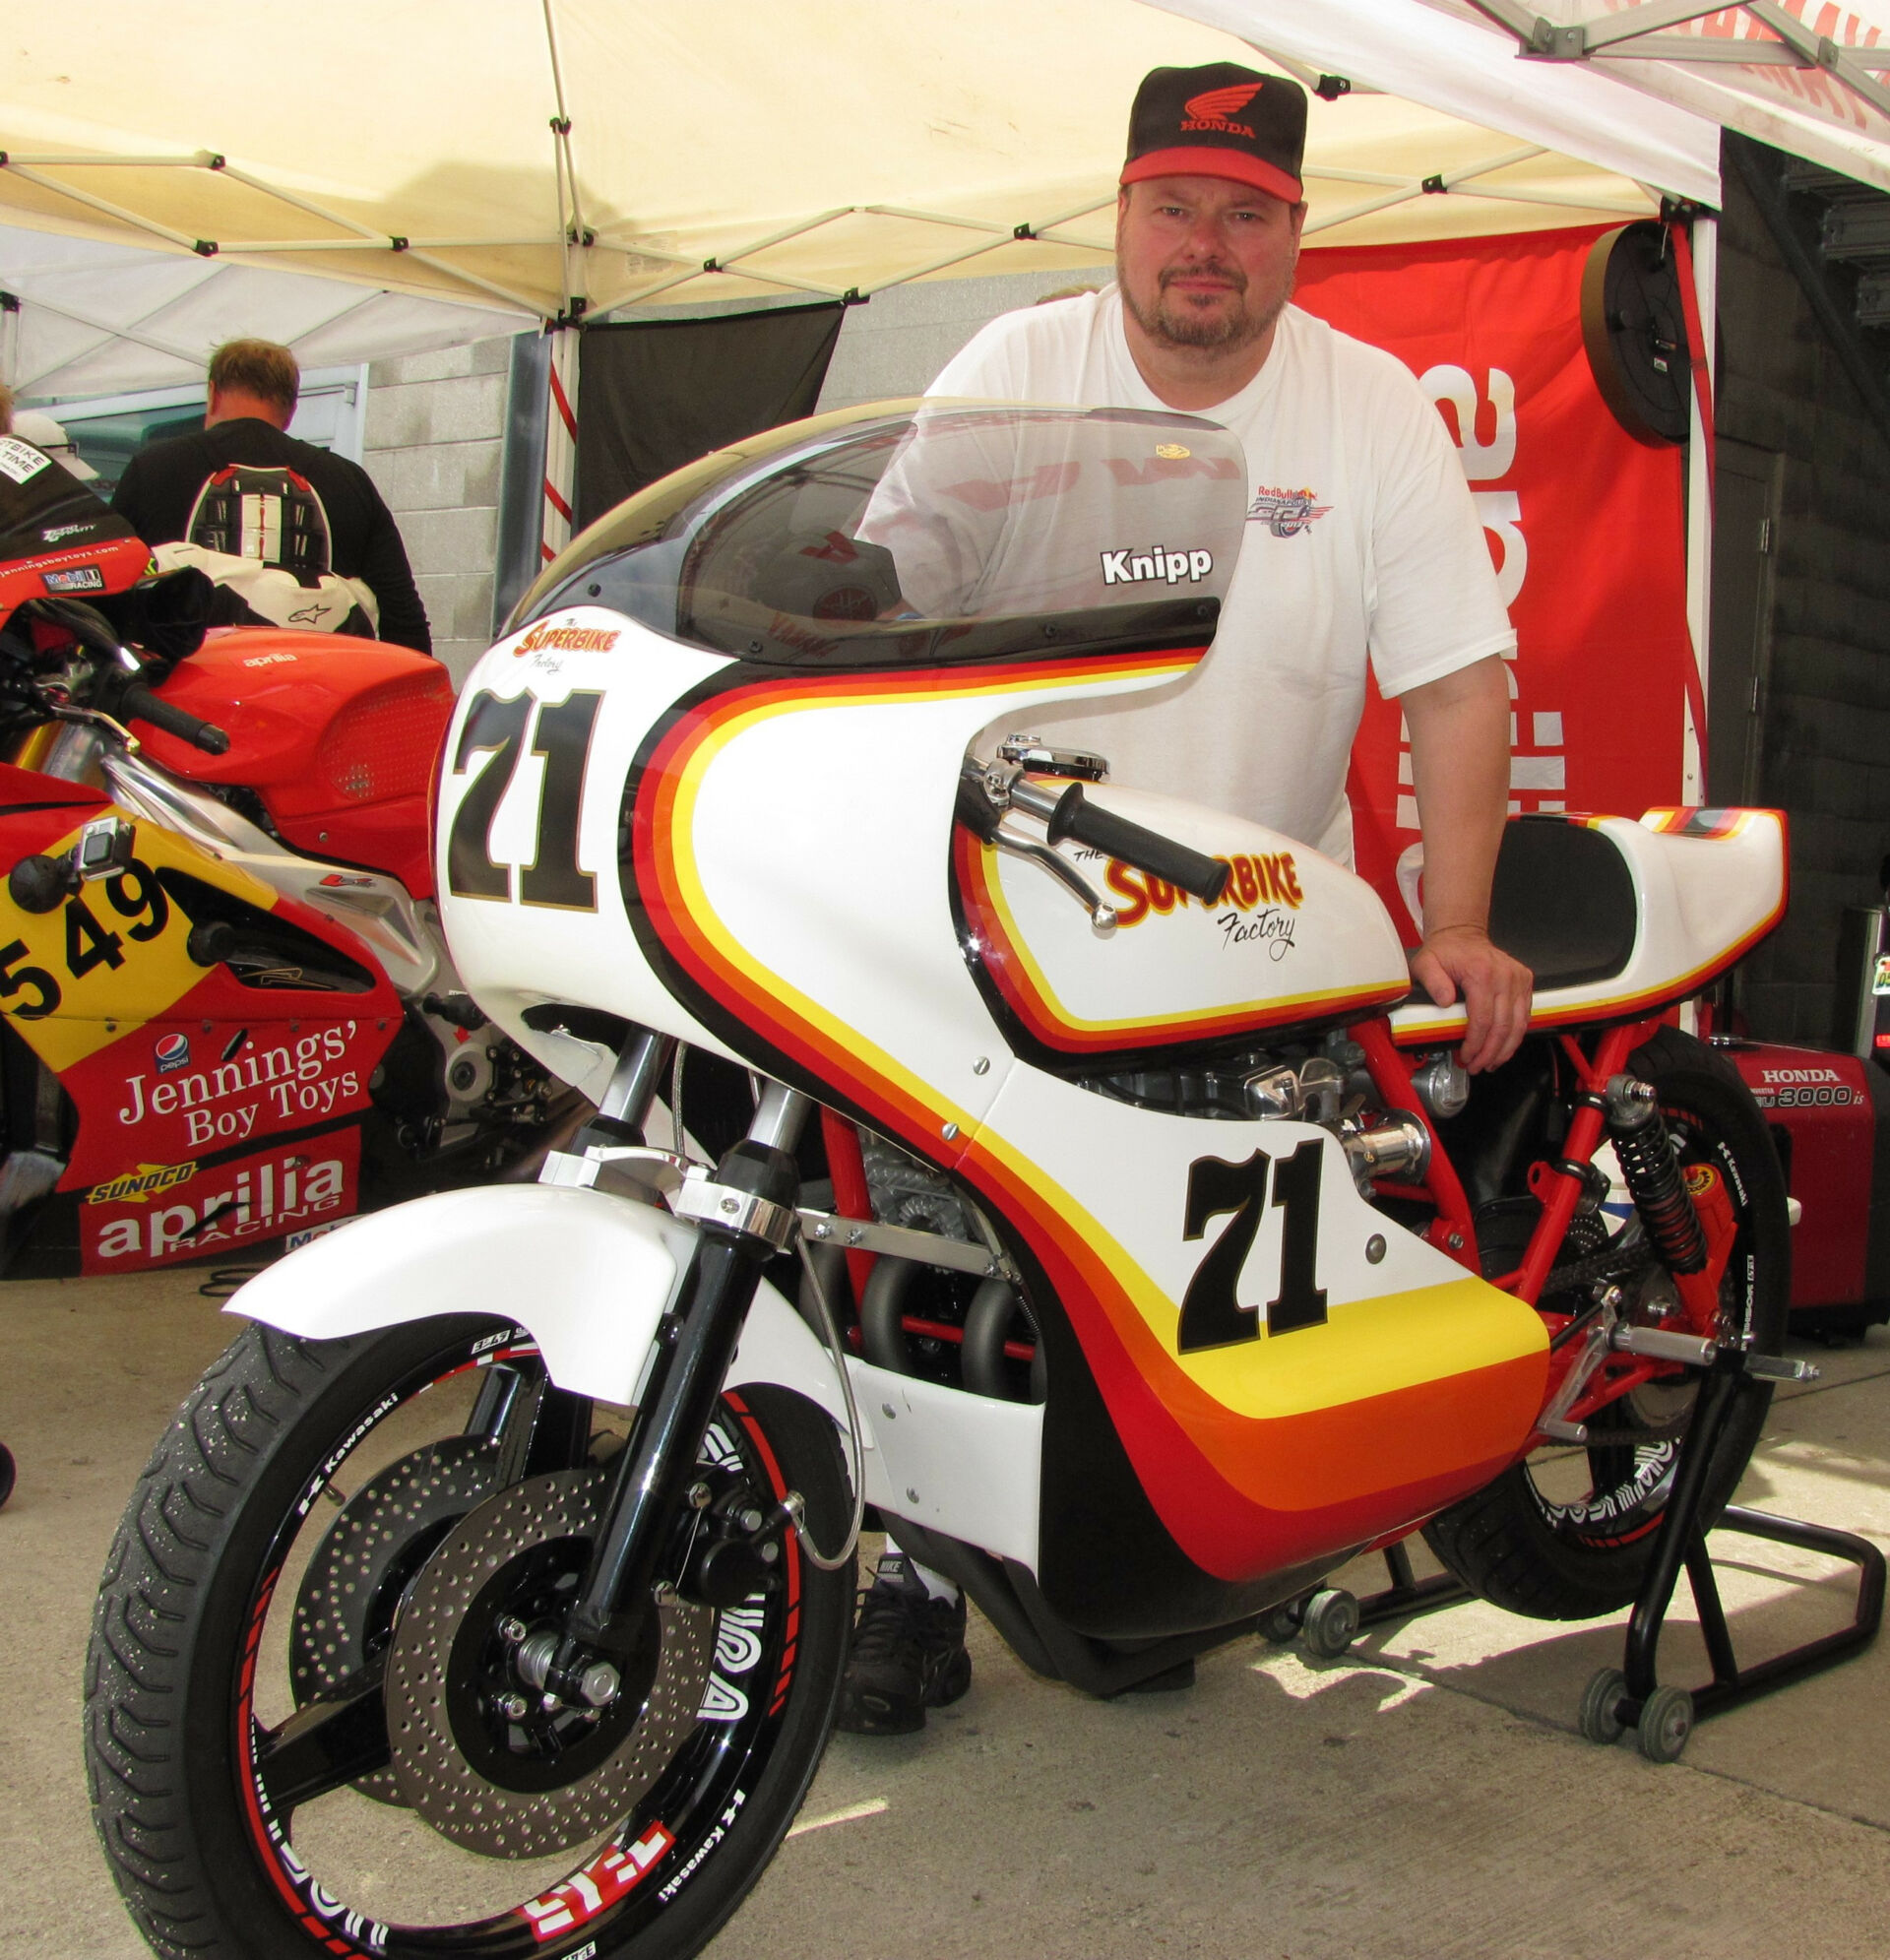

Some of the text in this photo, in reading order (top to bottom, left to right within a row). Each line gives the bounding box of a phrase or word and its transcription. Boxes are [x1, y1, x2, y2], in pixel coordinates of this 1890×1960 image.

[1181, 118, 1256, 139] HONDA
[44, 570, 85, 585] Mobil
[71, 579, 103, 590] RACING
[1100, 546, 1214, 587] Knipp
[243, 652, 297, 667] aprilia
[447, 686, 607, 914] 71
[0, 857, 169, 1020] 549
[1217, 908, 1296, 962] Factory
[159, 1054, 191, 1074] pepsi
[1761, 1068, 1840, 1083] HONDA
[183, 1070, 359, 1147] Boy Toys
[92, 1166, 194, 1204] SUNOCO
[97, 1156, 344, 1259] aprilia
[169, 1194, 341, 1253] RACING
[1177, 1137, 1329, 1357] 71
[324, 1392, 399, 1474] Kawasaki
[879, 1560, 902, 1573] NIKE
[657, 1824, 725, 1902] Kawasaki
